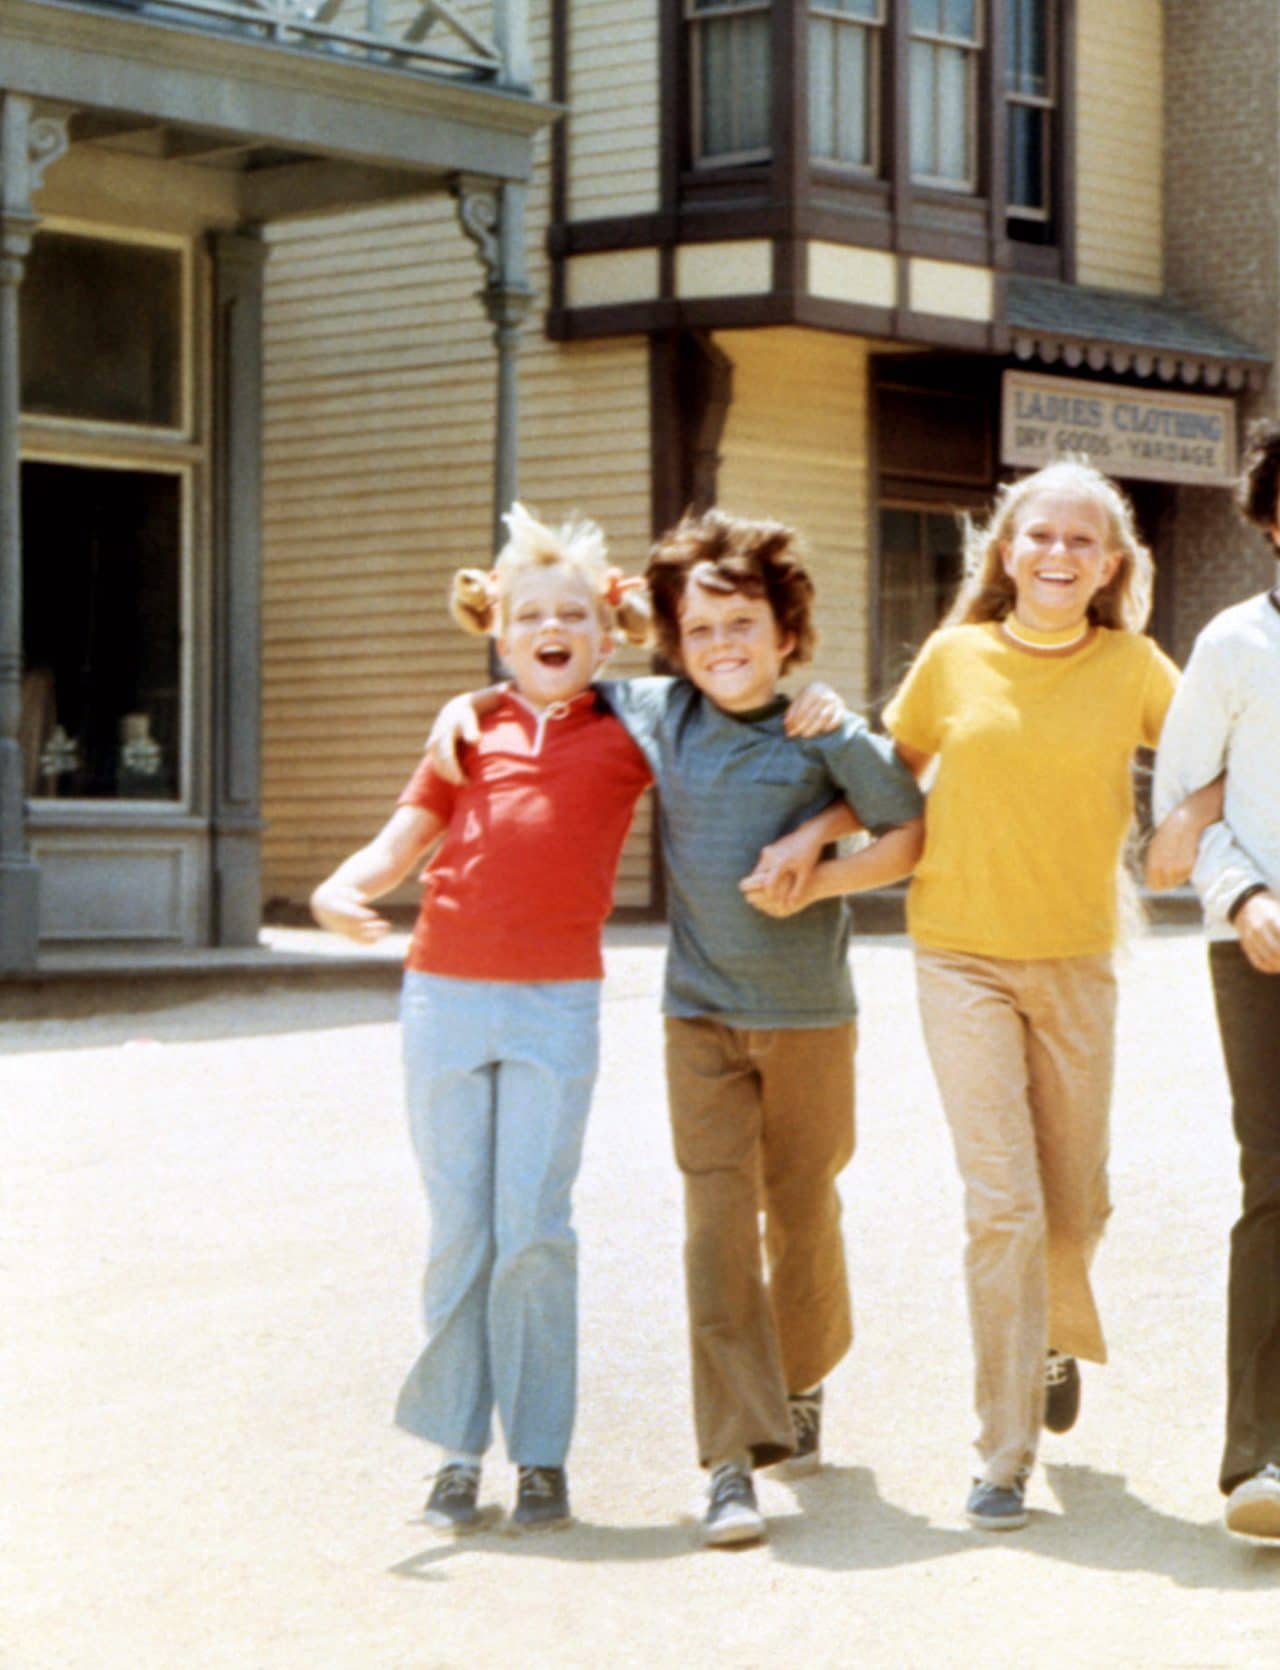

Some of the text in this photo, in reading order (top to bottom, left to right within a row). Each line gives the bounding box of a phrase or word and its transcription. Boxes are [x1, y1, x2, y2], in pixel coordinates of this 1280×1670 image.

[1014, 391, 1222, 441] LADIES CLOTHING
[1015, 426, 1046, 449] DRY
[1055, 430, 1112, 456] GOODS
[1127, 439, 1216, 467] YARDAGE
